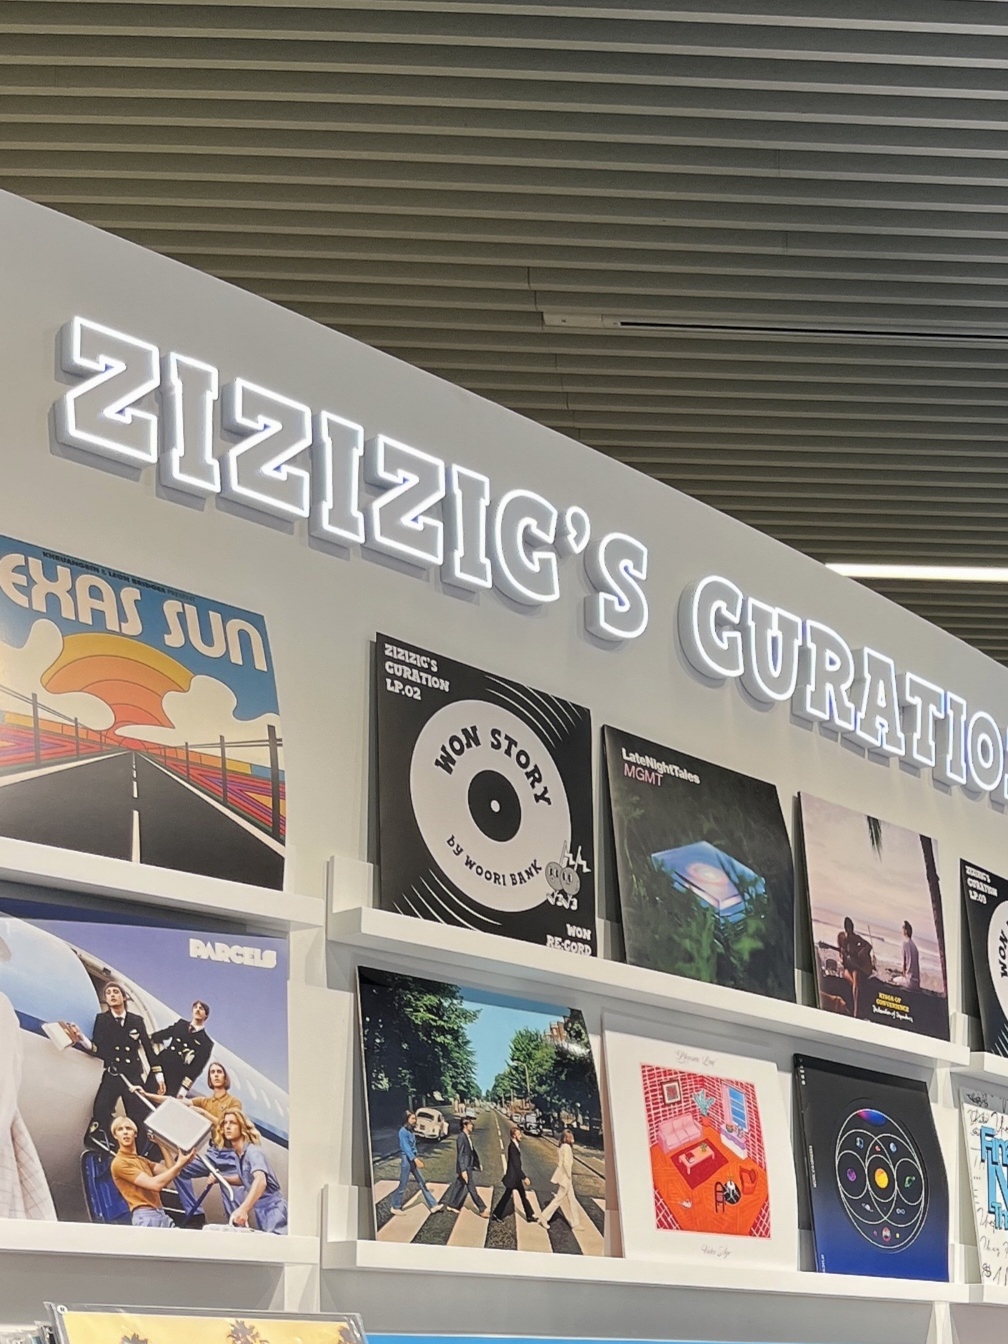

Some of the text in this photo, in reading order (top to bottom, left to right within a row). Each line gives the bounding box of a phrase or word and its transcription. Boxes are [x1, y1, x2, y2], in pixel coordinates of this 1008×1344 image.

[108, 570, 130, 583] LEON
[0, 553, 268, 672] EXAS SUN
[385, 661, 450, 692] CURATION
[386, 678, 422, 700] LP.02
[434, 725, 552, 806] WON STORY
[622, 747, 700, 784] LateNightTales
[624, 763, 663, 786] MGMT
[446, 835, 542, 886] by WOORI BANK
[967, 878, 998, 898] CURATION
[566, 923, 592, 940] WON
[189, 938, 277, 969] PARCELS
